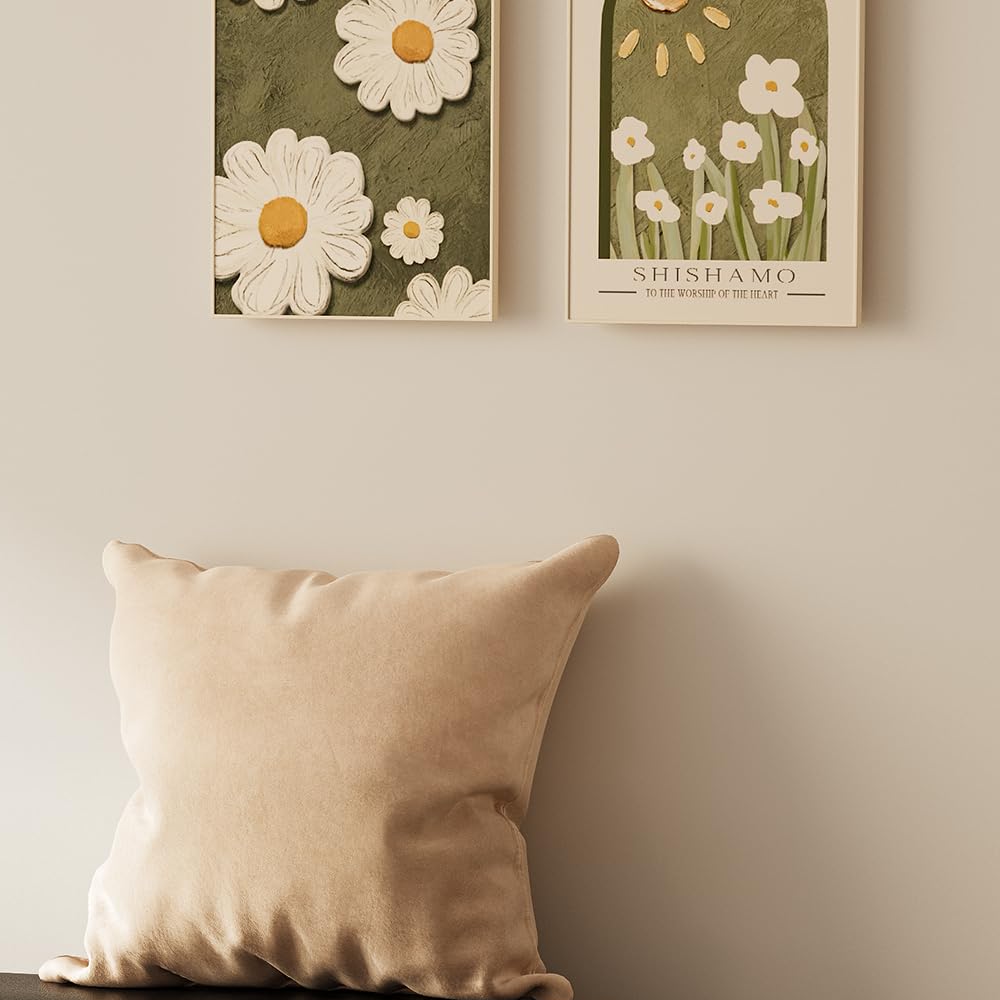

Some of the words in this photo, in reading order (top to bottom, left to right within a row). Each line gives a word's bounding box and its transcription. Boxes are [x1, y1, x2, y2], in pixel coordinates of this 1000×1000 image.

[633, 266, 796, 284] SHISHAMO
[646, 288, 657, 298] TO
[659, 288, 675, 298] THE
[677, 288, 716, 298] WORSHIP
[718, 289, 730, 299] OF
[732, 289, 748, 299] THE
[750, 289, 778, 300] HEART
